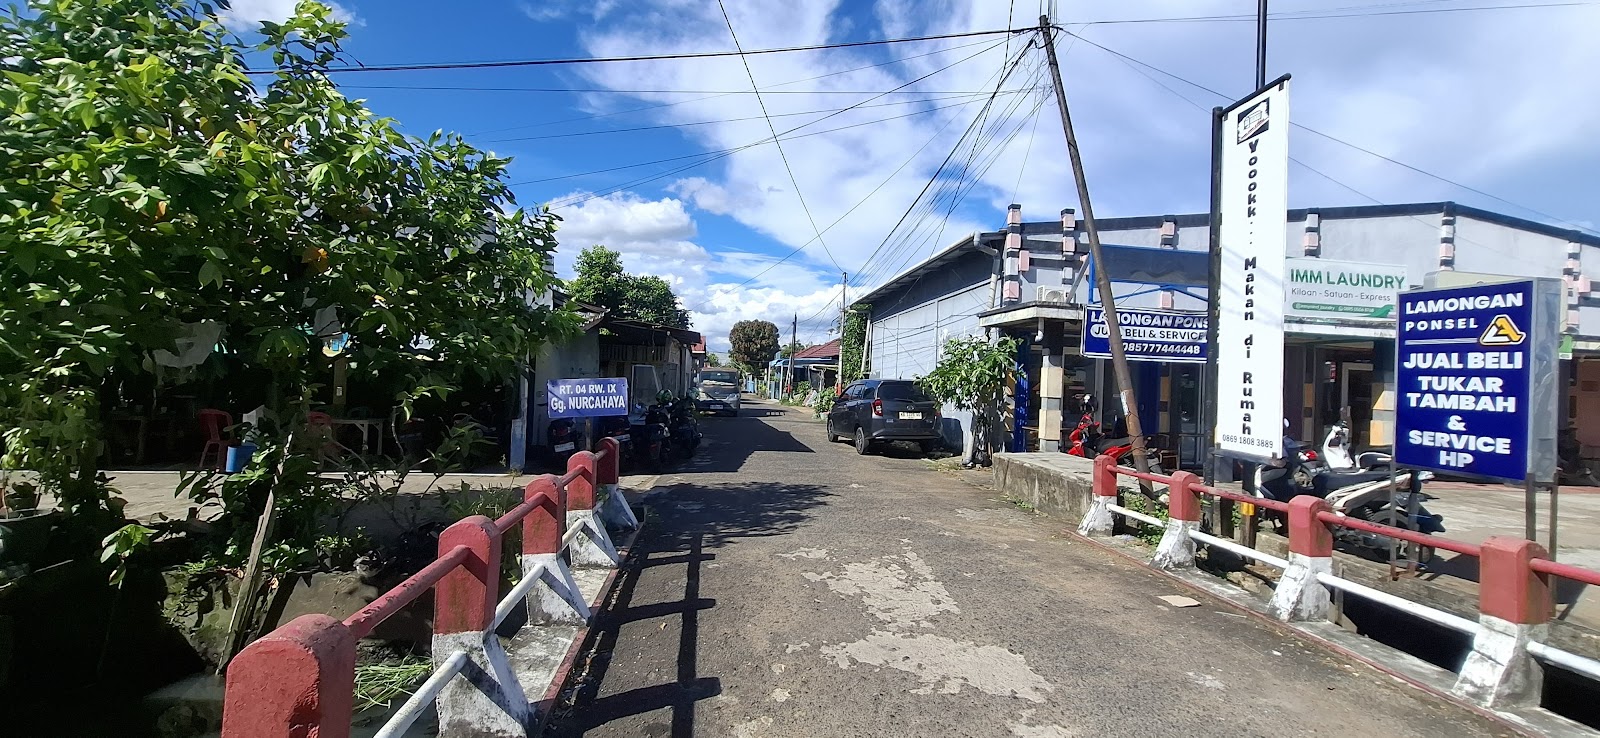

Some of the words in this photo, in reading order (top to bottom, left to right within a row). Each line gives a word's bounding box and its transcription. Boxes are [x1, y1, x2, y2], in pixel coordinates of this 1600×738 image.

[1290, 268, 1323, 284] IMM
[1326, 271, 1405, 289] LAUNDRY
[1244, 256, 1257, 321] Makan
[1291, 288, 1317, 297] Kiloan
[1324, 290, 1354, 299] Satuan
[1360, 292, 1391, 302] Express
[1405, 292, 1524, 315] LAMONGAN
[1125, 328, 1146, 338] BELI
[1148, 330, 1157, 339] &
[1405, 317, 1478, 332] PONSEL
[1244, 334, 1254, 359] di
[1403, 352, 1463, 369] JUAL
[1466, 351, 1523, 369] BELI
[560, 385, 573, 394] RT.
[575, 384, 587, 394] 04
[588, 384, 605, 394] RW.
[608, 384, 616, 393] IX
[1417, 375, 1504, 393] TUKAR
[551, 397, 567, 413] Gg.
[569, 396, 625, 409] NURCAHAYA
[1240, 371, 1255, 435] Rumah
[1406, 392, 1517, 413] TAMBAH
[1447, 415, 1467, 431] &
[1239, 436, 1255, 446] 1808
[1408, 429, 1512, 455] SERVICE
[1439, 450, 1474, 468] HP
